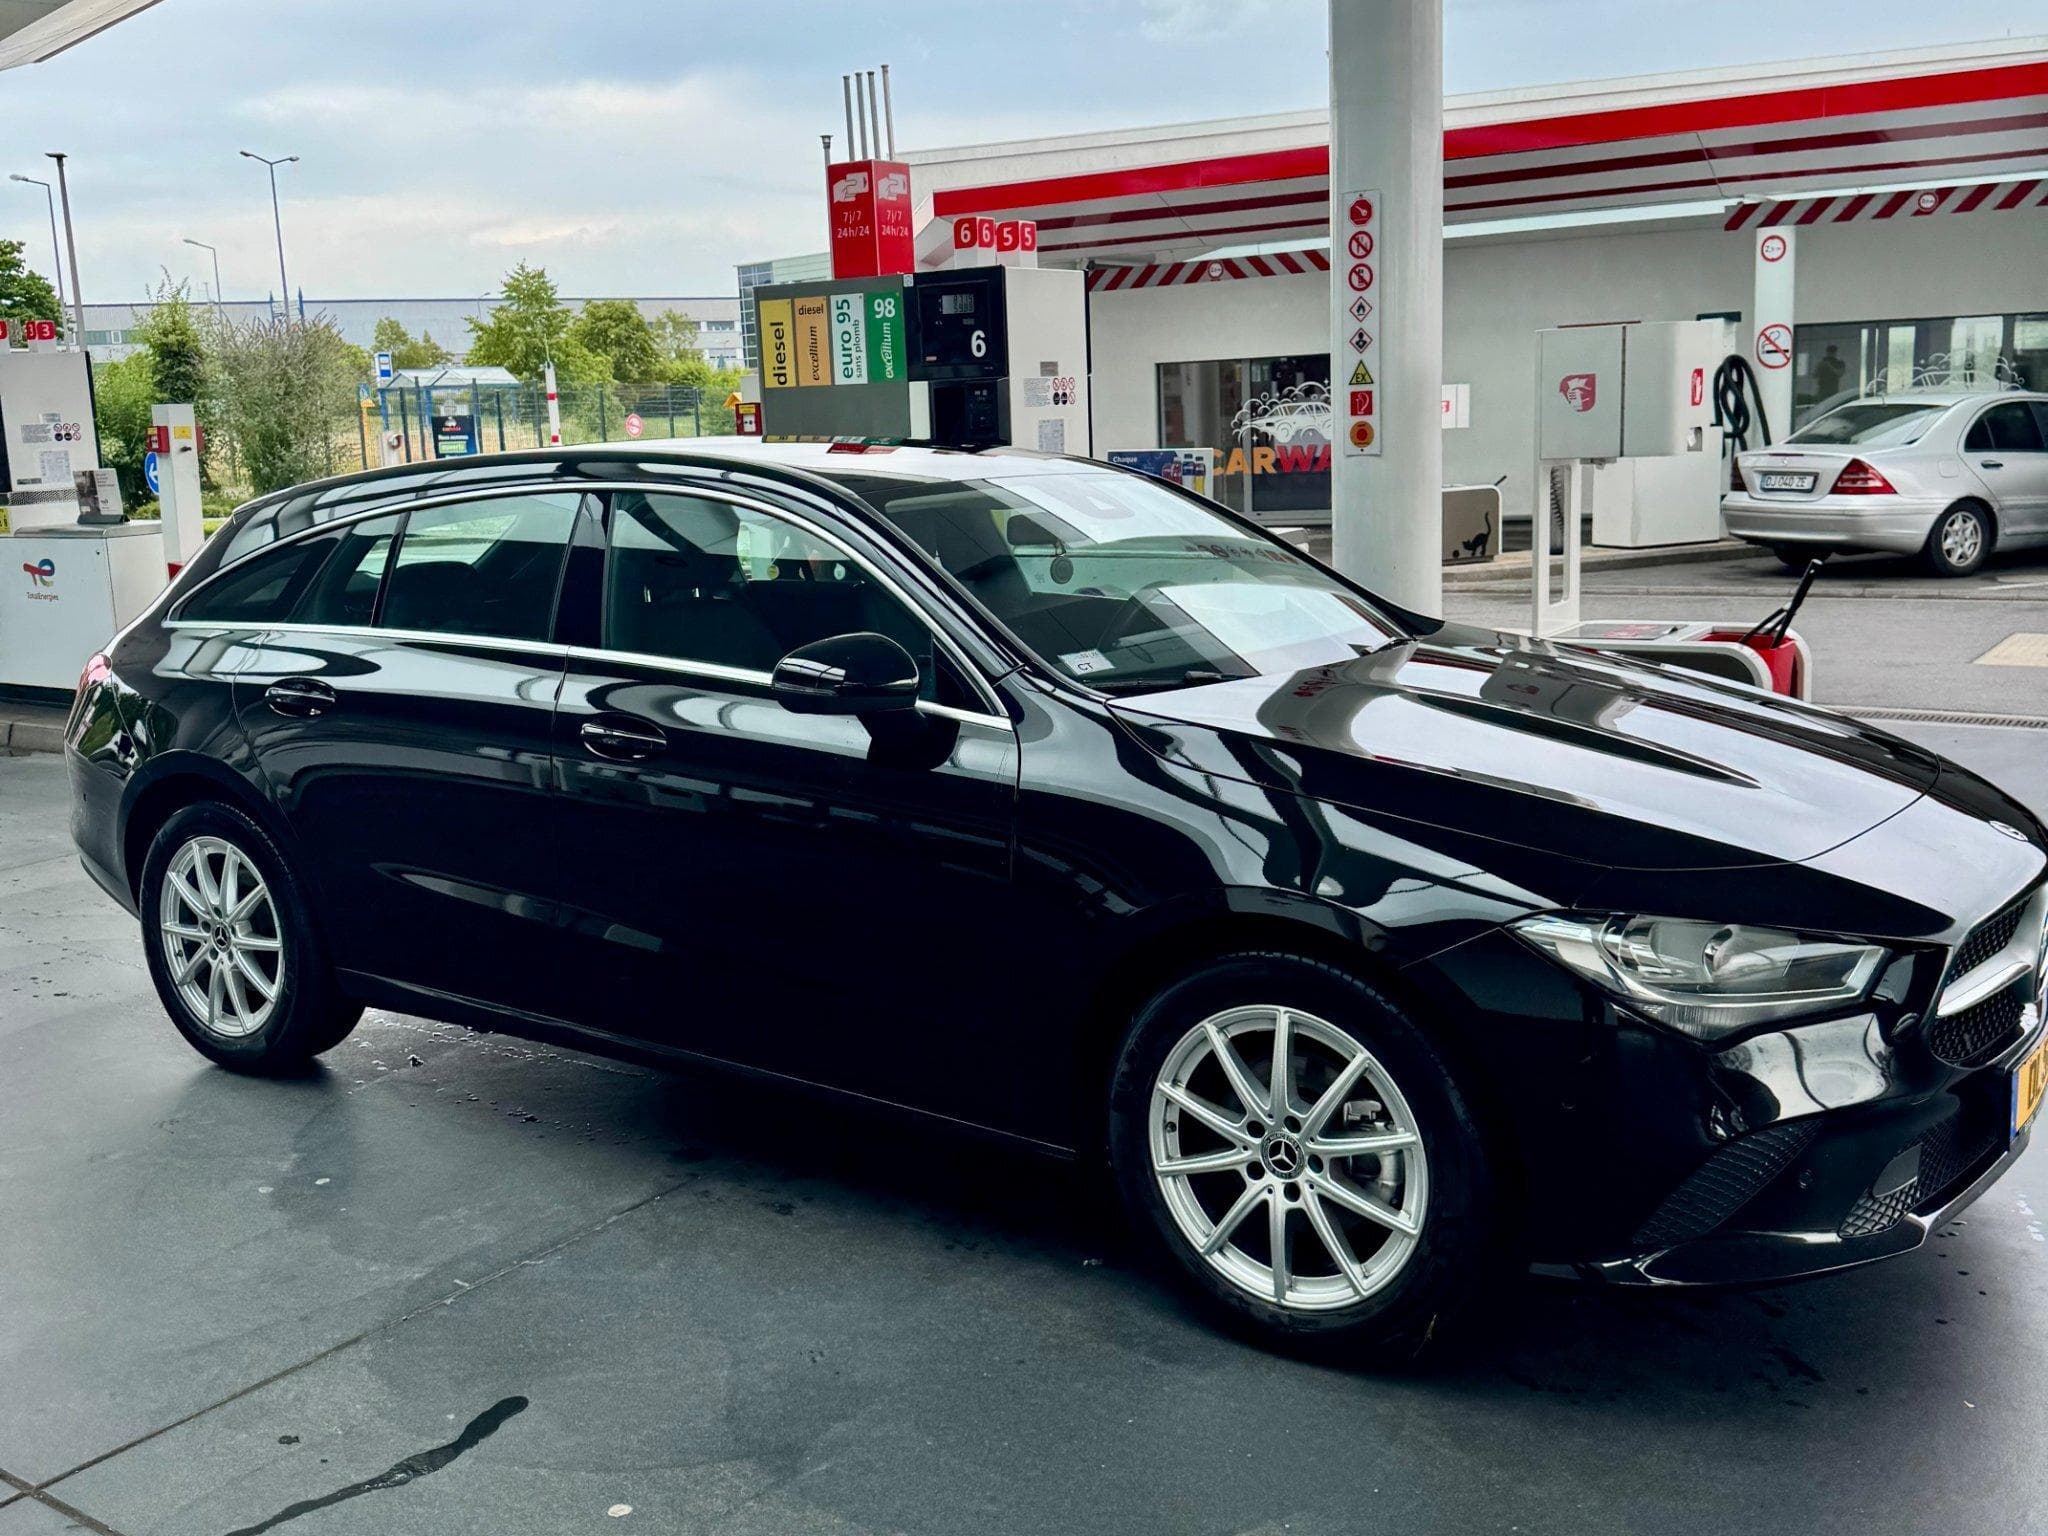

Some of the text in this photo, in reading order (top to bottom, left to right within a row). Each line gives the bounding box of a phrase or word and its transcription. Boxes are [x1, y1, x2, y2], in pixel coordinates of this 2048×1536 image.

[843, 211, 861, 224] 7j/7
[886, 210, 902, 223] 7j/7
[837, 225, 870, 239] 24h/24
[881, 224, 909, 238] 24h/24
[960, 223, 971, 244] 6
[982, 222, 991, 243] 6
[1003, 227, 1013, 247] 5
[1024, 227, 1032, 246] 5
[798, 303, 824, 316] diesel
[873, 298, 895, 319] 98
[41, 323, 51, 337] 3
[836, 299, 854, 379] euro 95
[769, 321, 788, 386] diesel
[809, 326, 820, 381] excellium
[852, 319, 864, 379] sans plomb
[881, 322, 894, 379] excellium
[971, 329, 987, 358] 6
[1355, 372, 1367, 383] EX
[1112, 456, 1138, 465] Chaque
